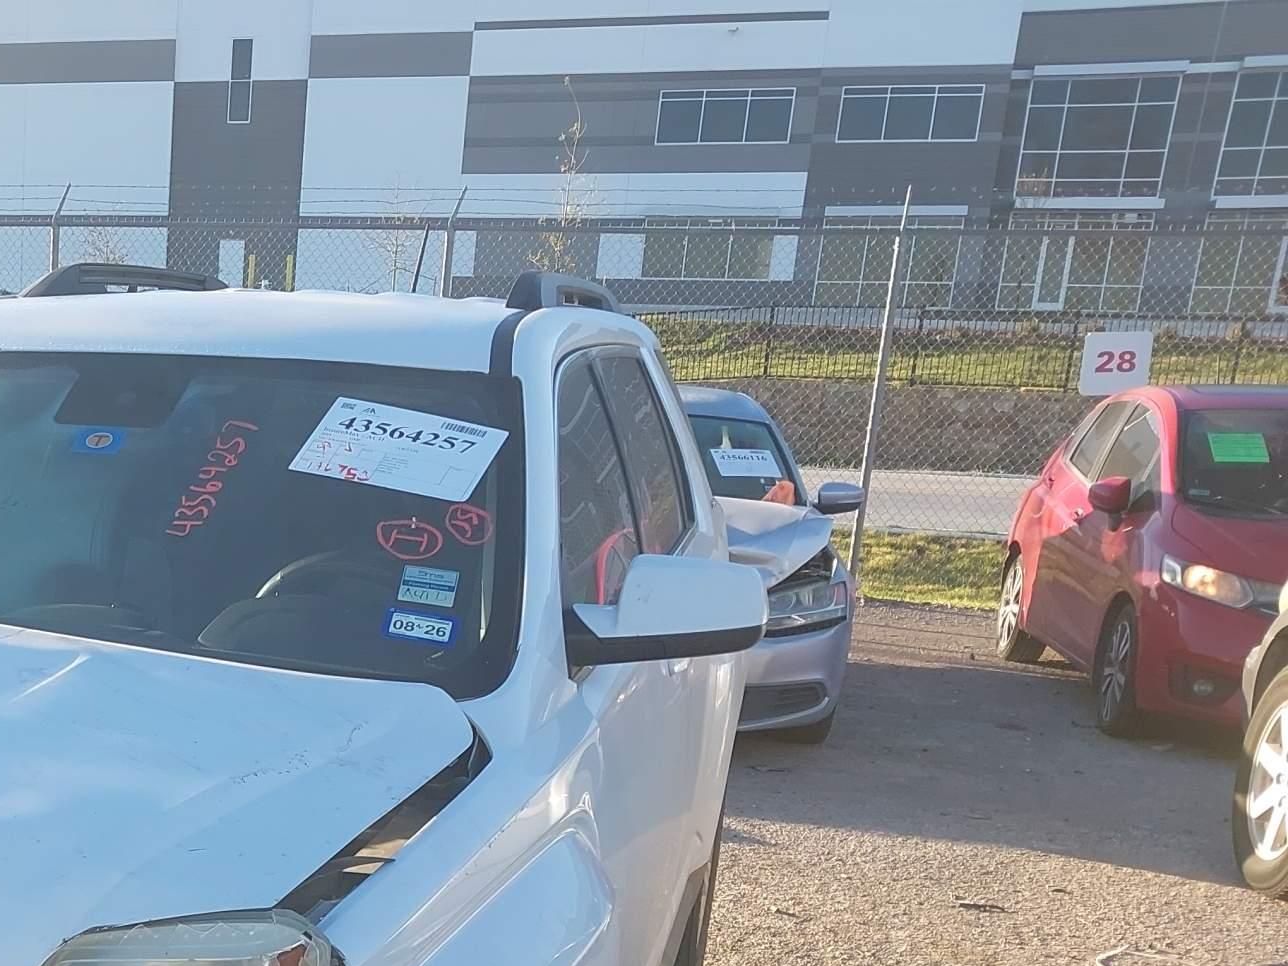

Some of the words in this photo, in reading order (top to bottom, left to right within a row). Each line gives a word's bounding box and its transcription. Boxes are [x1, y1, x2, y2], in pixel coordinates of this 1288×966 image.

[1094, 350, 1137, 373] 28
[338, 416, 478, 454] 43564257
[165, 420, 259, 536] 43564257
[392, 619, 416, 632] 08
[423, 624, 449, 638] 26
